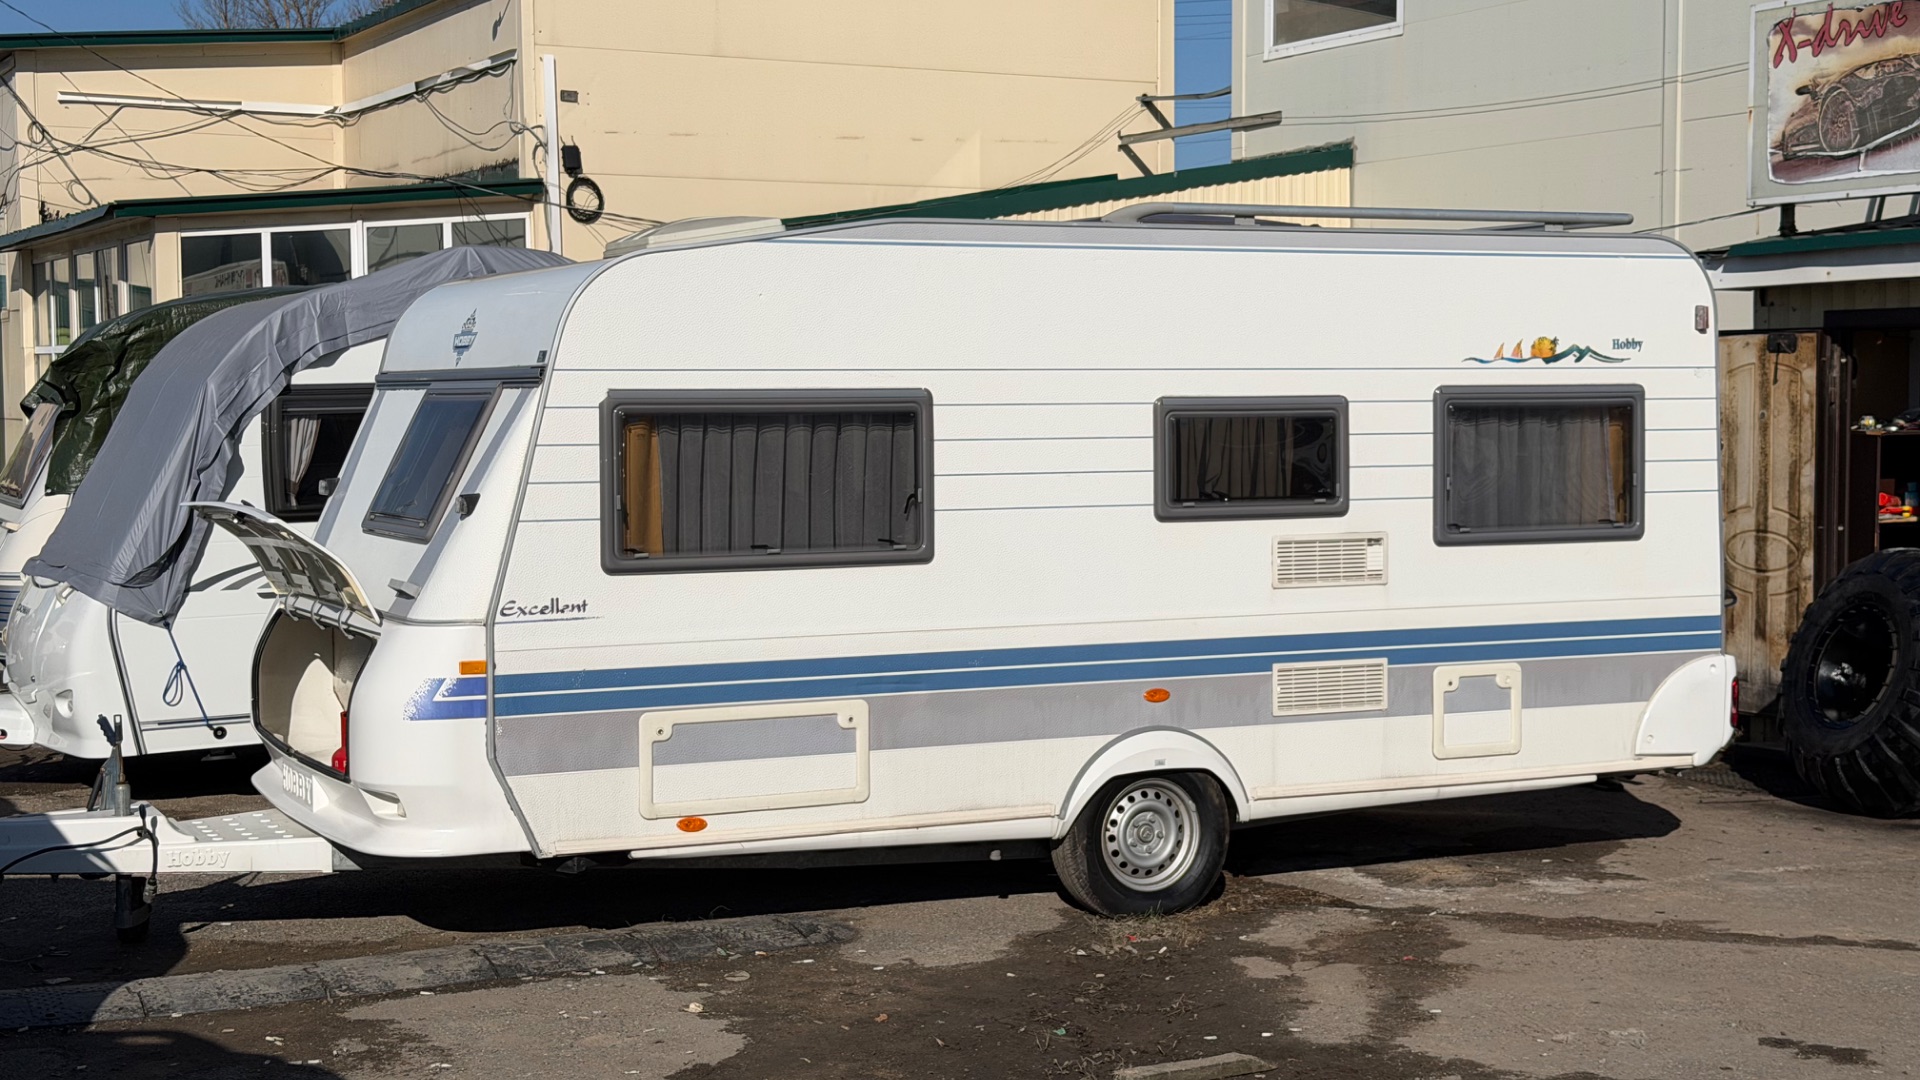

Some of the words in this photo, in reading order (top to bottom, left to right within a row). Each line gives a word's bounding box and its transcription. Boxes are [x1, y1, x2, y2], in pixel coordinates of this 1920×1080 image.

[1772, 1, 1908, 69] X-drive
[1612, 338, 1644, 352] Hobby
[500, 597, 589, 618] Excellent
[165, 846, 231, 869] Hobby
